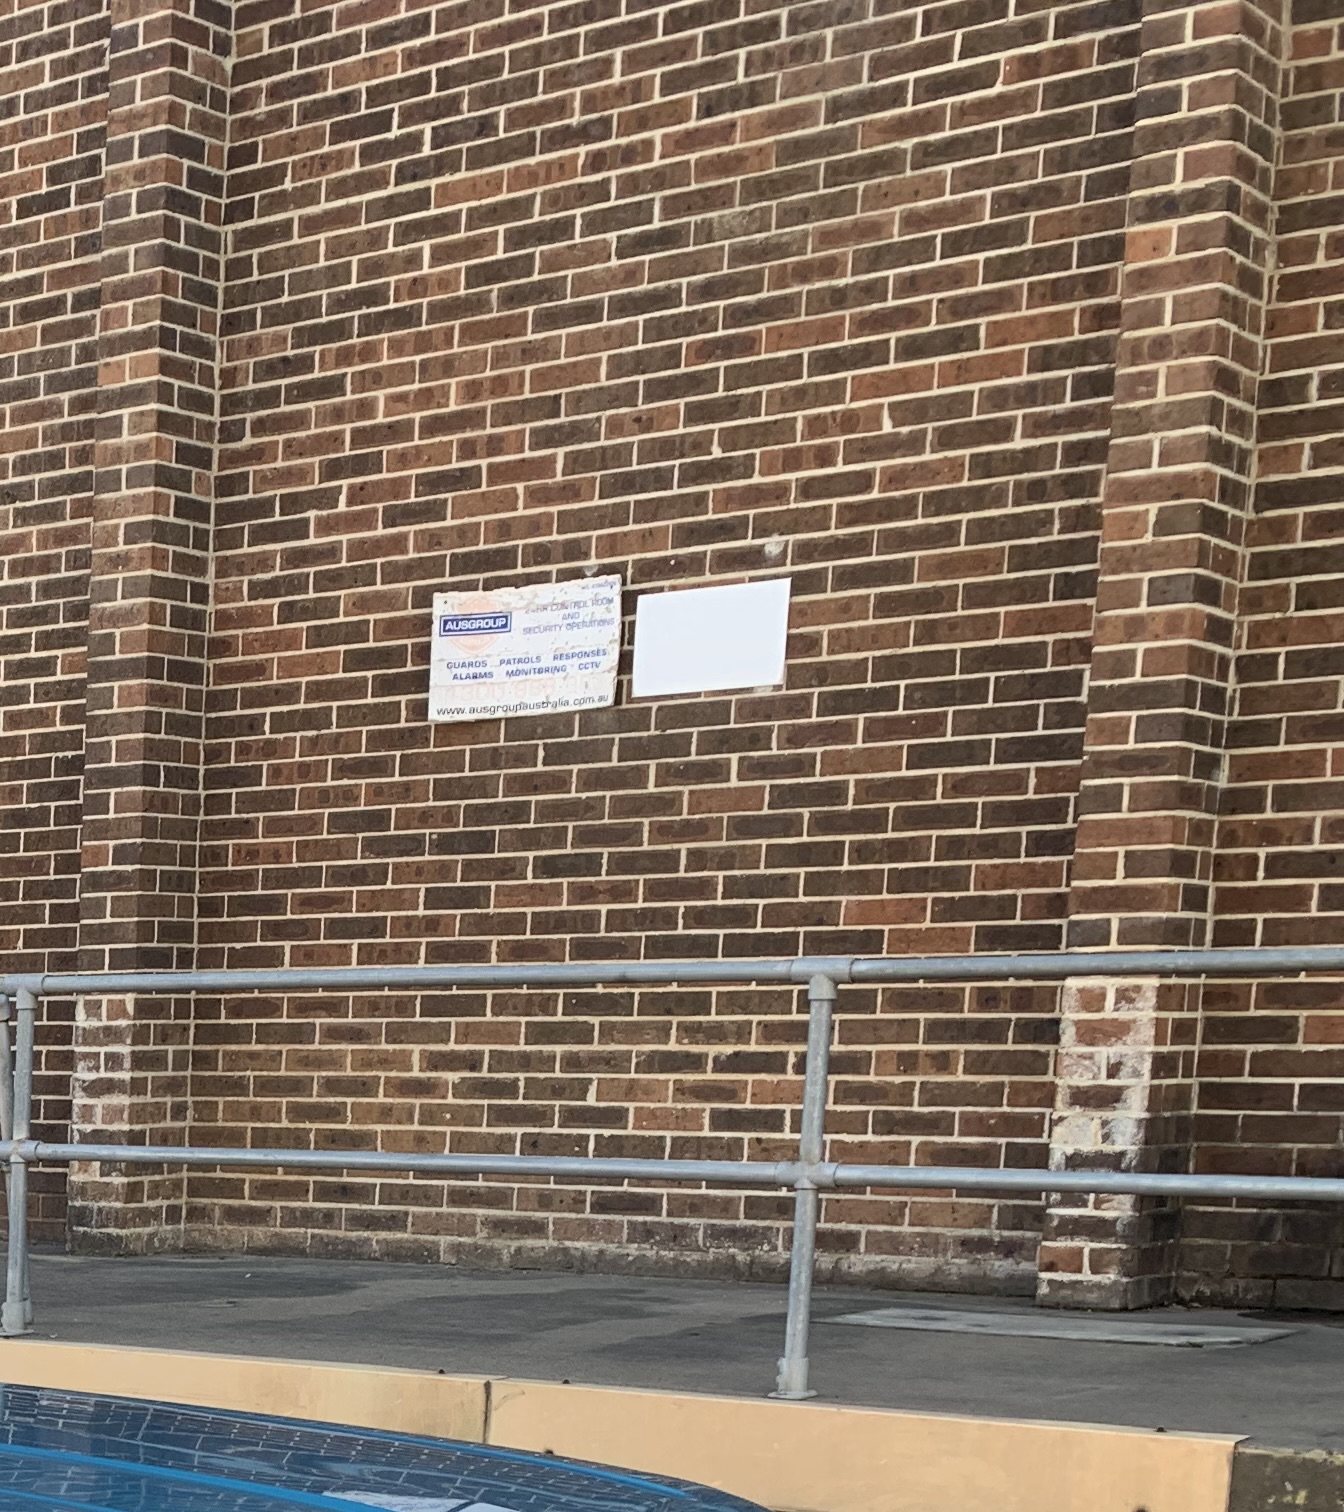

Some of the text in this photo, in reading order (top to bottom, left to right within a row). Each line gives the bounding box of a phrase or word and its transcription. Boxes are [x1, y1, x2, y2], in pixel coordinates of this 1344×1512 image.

[445, 617, 507, 631] AUSGROUP
[522, 617, 615, 635] SECURITY OPERATIONS
[561, 612, 580, 621] AND
[446, 648, 607, 670] GUARDS PATROLS RESPONSES
[452, 661, 602, 681] ALARMS MONITORING CCTV
[436, 694, 609, 717] www.ausgroupaustralia.com.au
